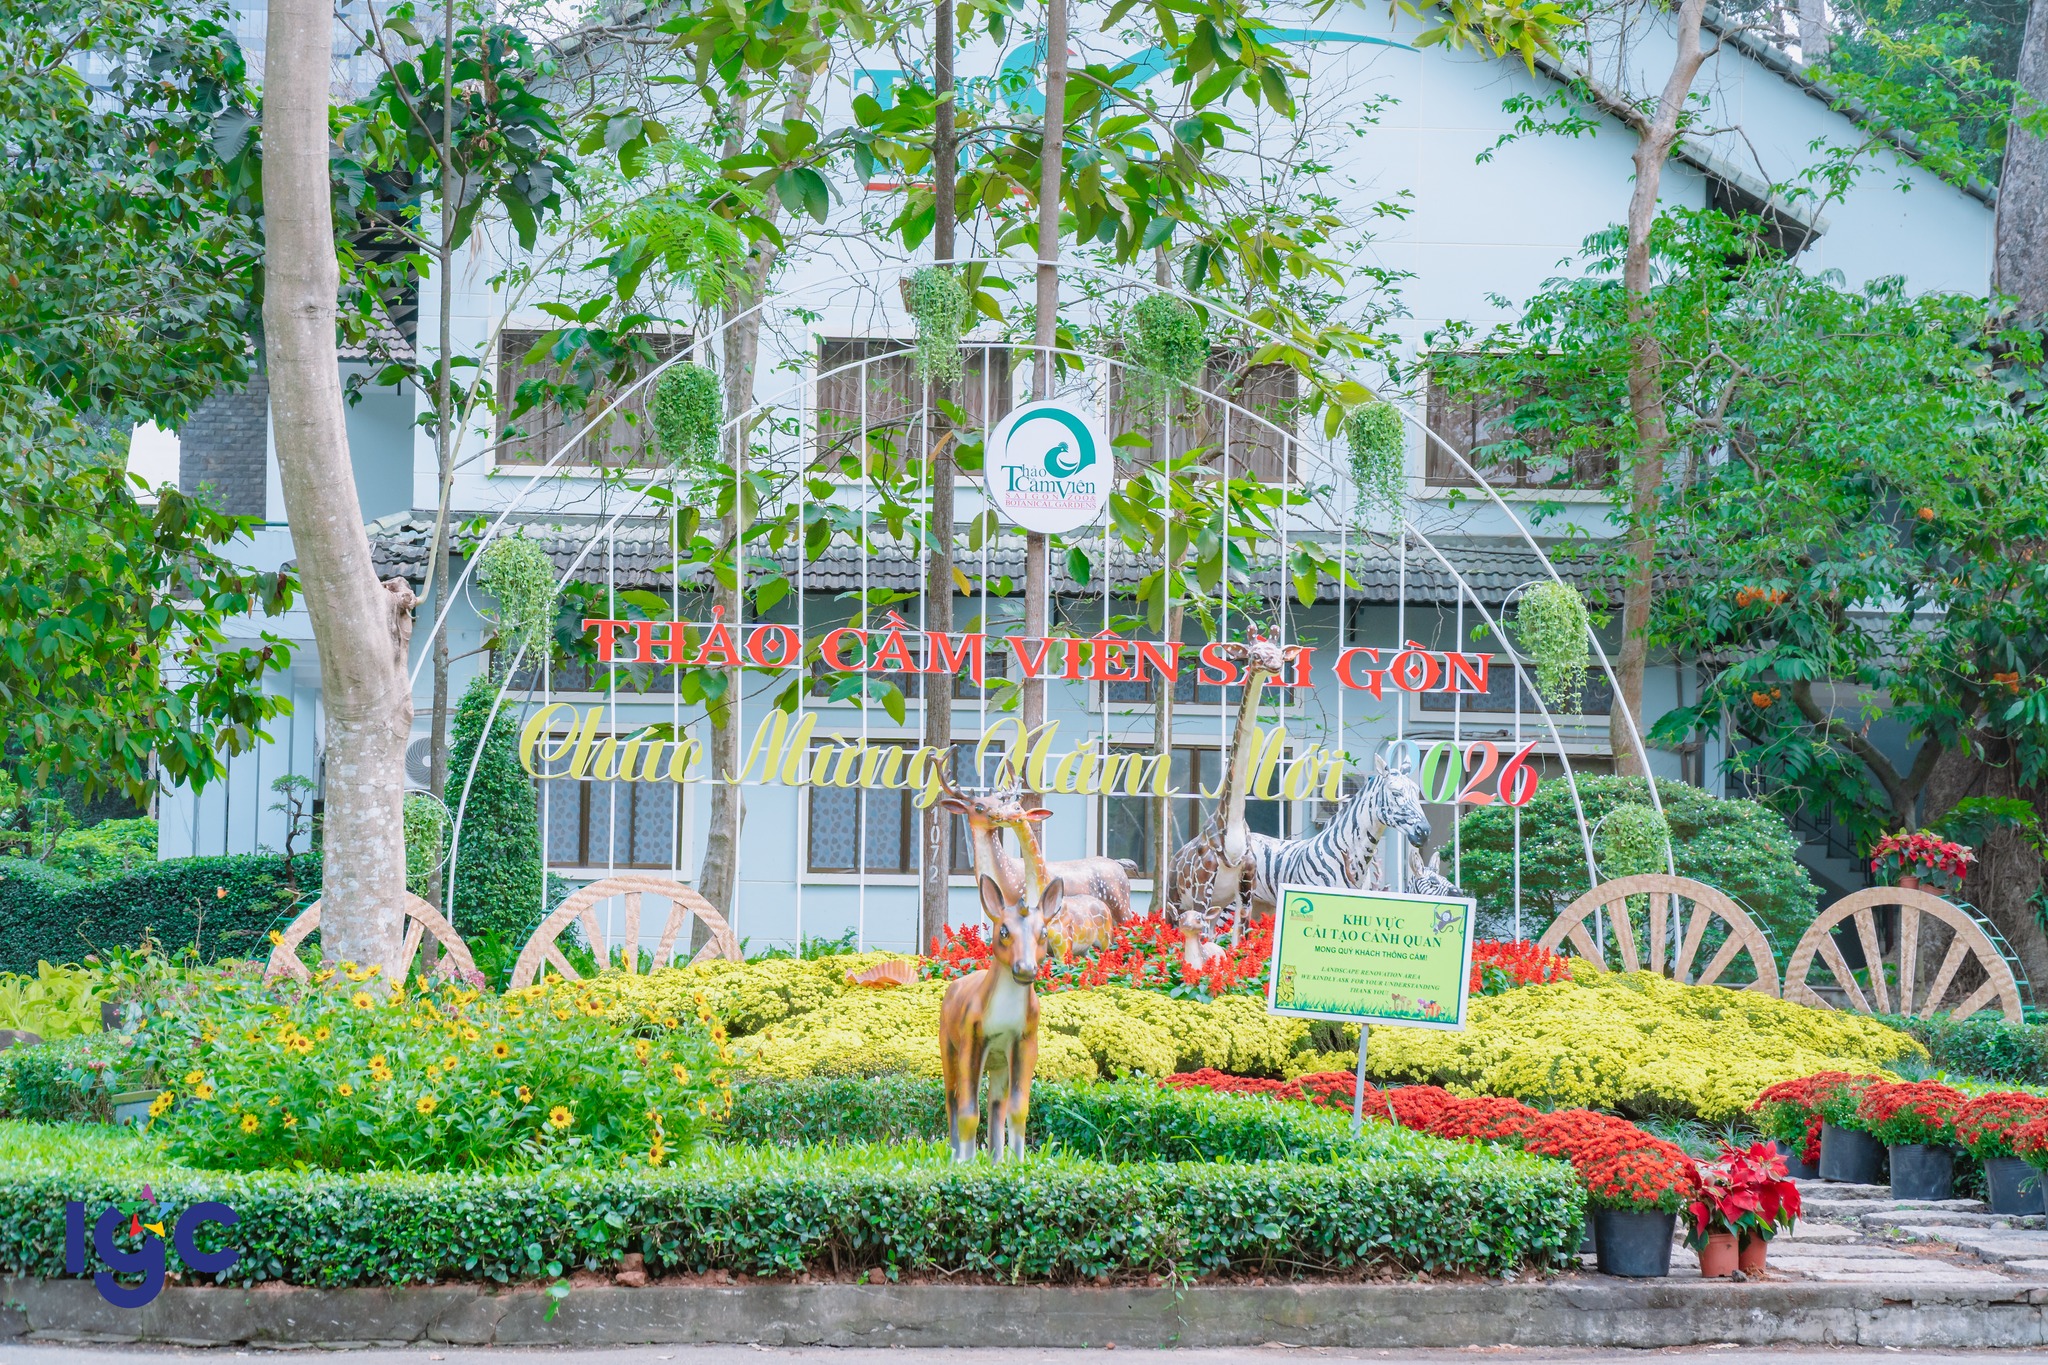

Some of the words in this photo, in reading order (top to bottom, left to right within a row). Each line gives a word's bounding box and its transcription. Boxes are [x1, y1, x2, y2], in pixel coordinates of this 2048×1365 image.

[1001, 464, 1047, 491] Thảo
[1005, 492, 1059, 500] SAIGON
[1056, 480, 1095, 499] Viên
[582, 605, 803, 668] THẢO
[818, 610, 987, 687] CẦM
[1003, 629, 1185, 683] VIÊN
[1332, 640, 1495, 701] GÒN
[518, 702, 705, 784] Chúc
[722, 708, 957, 809] Mừng
[975, 717, 1180, 797] Năm
[1199, 726, 1351, 802] Mới
[929, 806, 940, 883] 1072
[1343, 914, 1372, 926] KHU
[1376, 916, 1405, 931] VỰC
[1303, 924, 1327, 938] CẢI
[1330, 928, 1358, 943] TẠO
[1361, 928, 1399, 944] CẢNH
[1403, 934, 1442, 948] QUAN
[1314, 945, 1336, 953] MONG
[1355, 947, 1380, 957] KHÁCH
[1321, 966, 1359, 974] LANDSCAPE
[1360, 970, 1402, 978] RENOVATION
[1384, 981, 1441, 991] UNDERSTANDING
